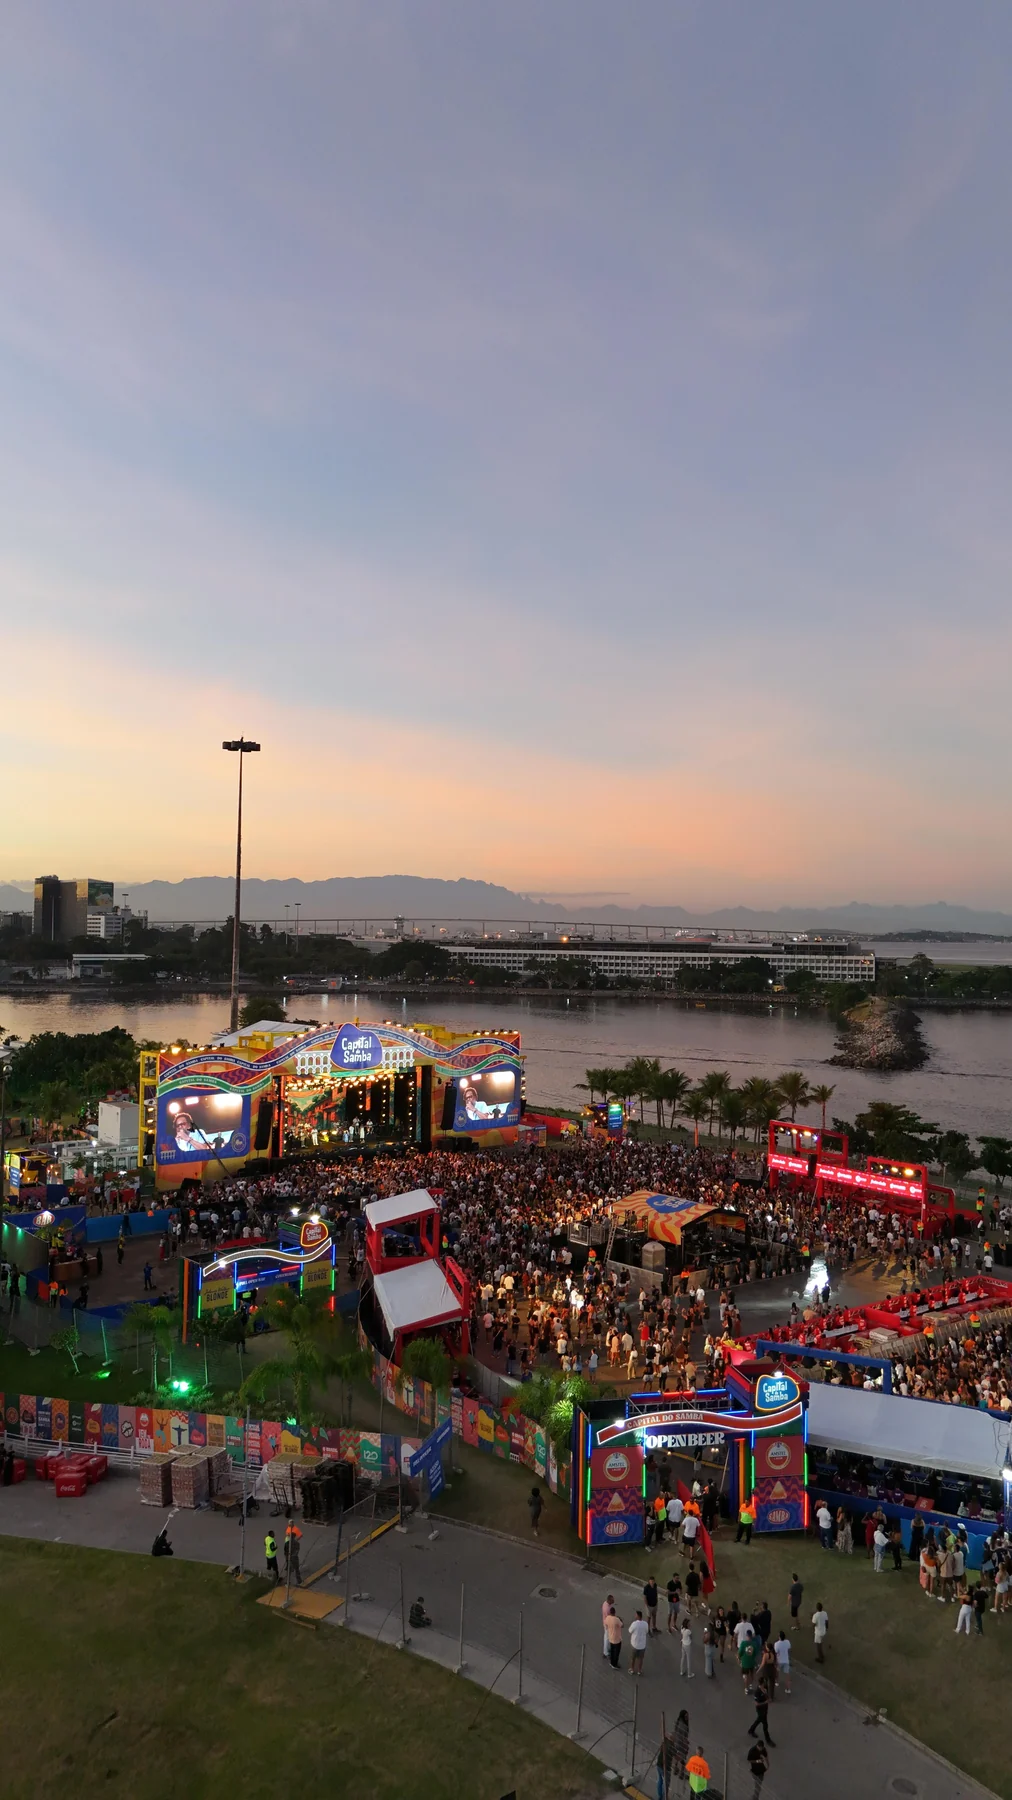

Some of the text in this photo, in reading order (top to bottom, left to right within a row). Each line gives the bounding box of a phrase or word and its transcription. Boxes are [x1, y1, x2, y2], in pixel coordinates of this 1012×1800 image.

[342, 1036, 372, 1053] Capital
[344, 1050, 372, 1063] Samba
[36, 1214, 52, 1226] BAR
[308, 1272, 328, 1282] BLONDE
[206, 1290, 228, 1302] BLONDE
[763, 1382, 788, 1398] Capital
[766, 1394, 788, 1403] Samba
[627, 1417, 660, 1429] CAPITAL
[676, 1412, 703, 1421] SAMBA
[646, 1432, 725, 1448] OPEN BEER
[768, 1510, 788, 1522] SAMBA
[606, 1522, 627, 1535] SAMBA
